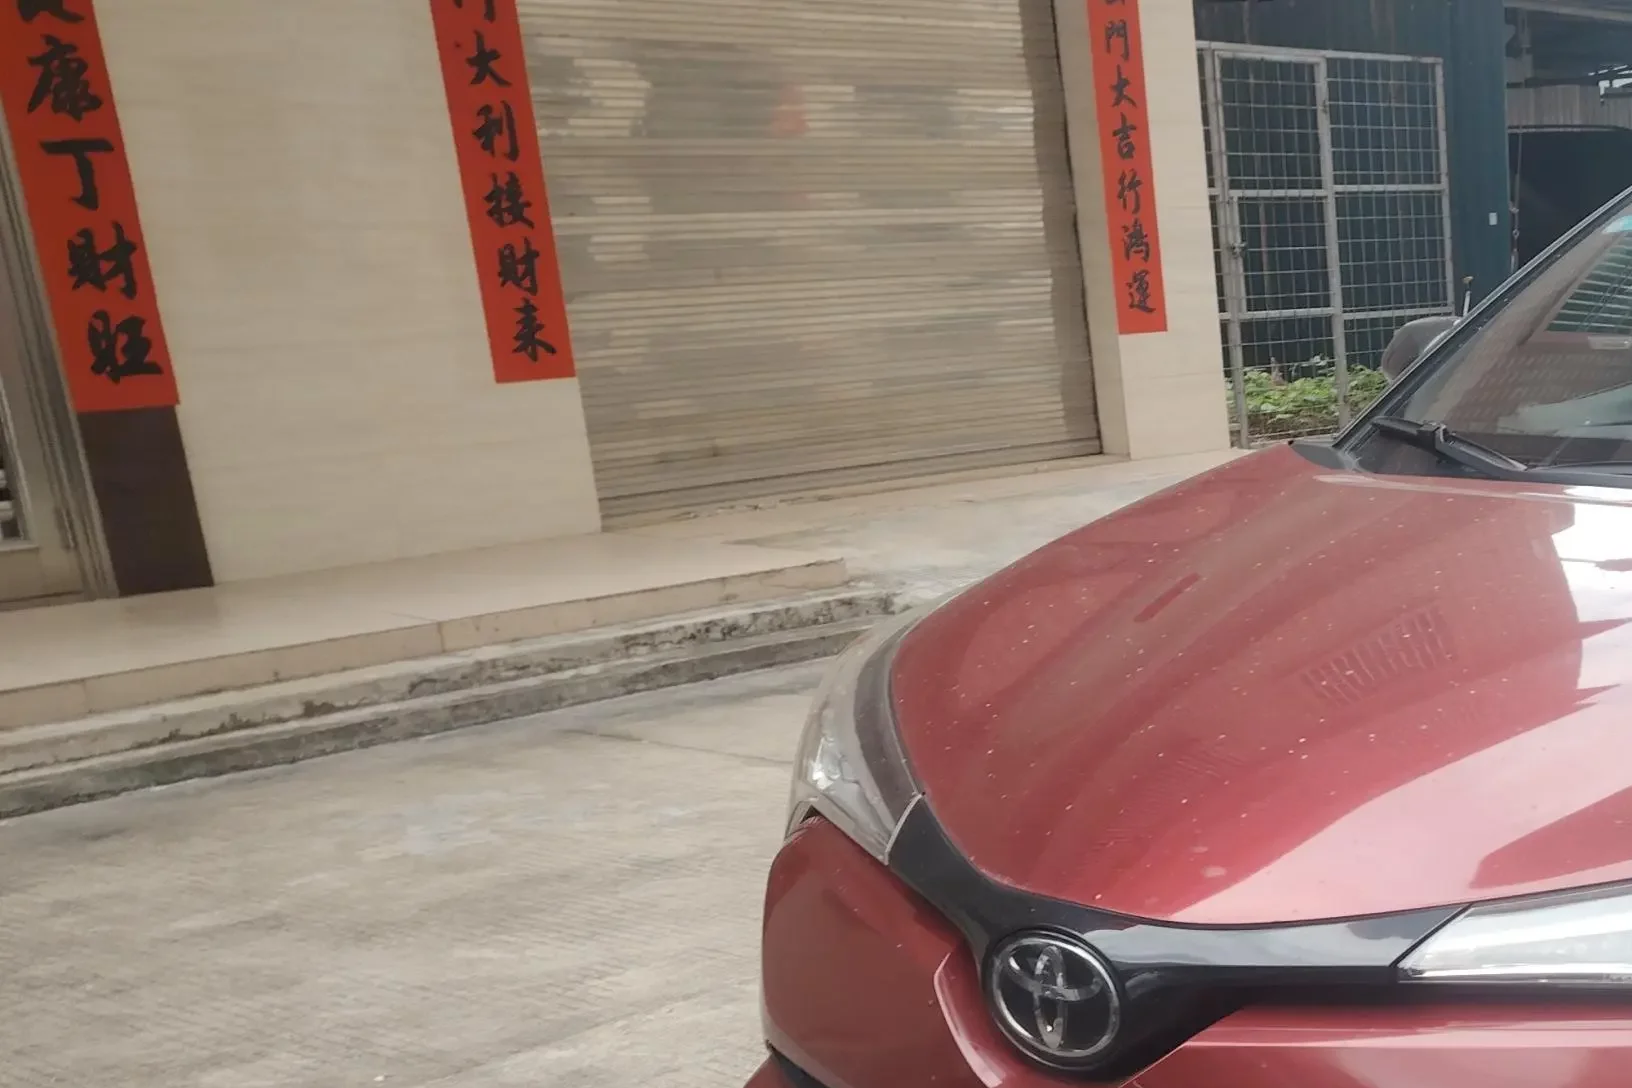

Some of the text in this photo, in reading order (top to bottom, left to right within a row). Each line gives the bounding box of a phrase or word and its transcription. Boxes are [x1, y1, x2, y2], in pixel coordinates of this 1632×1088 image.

[1104, 0, 1156, 314] 門大吉行鴻運
